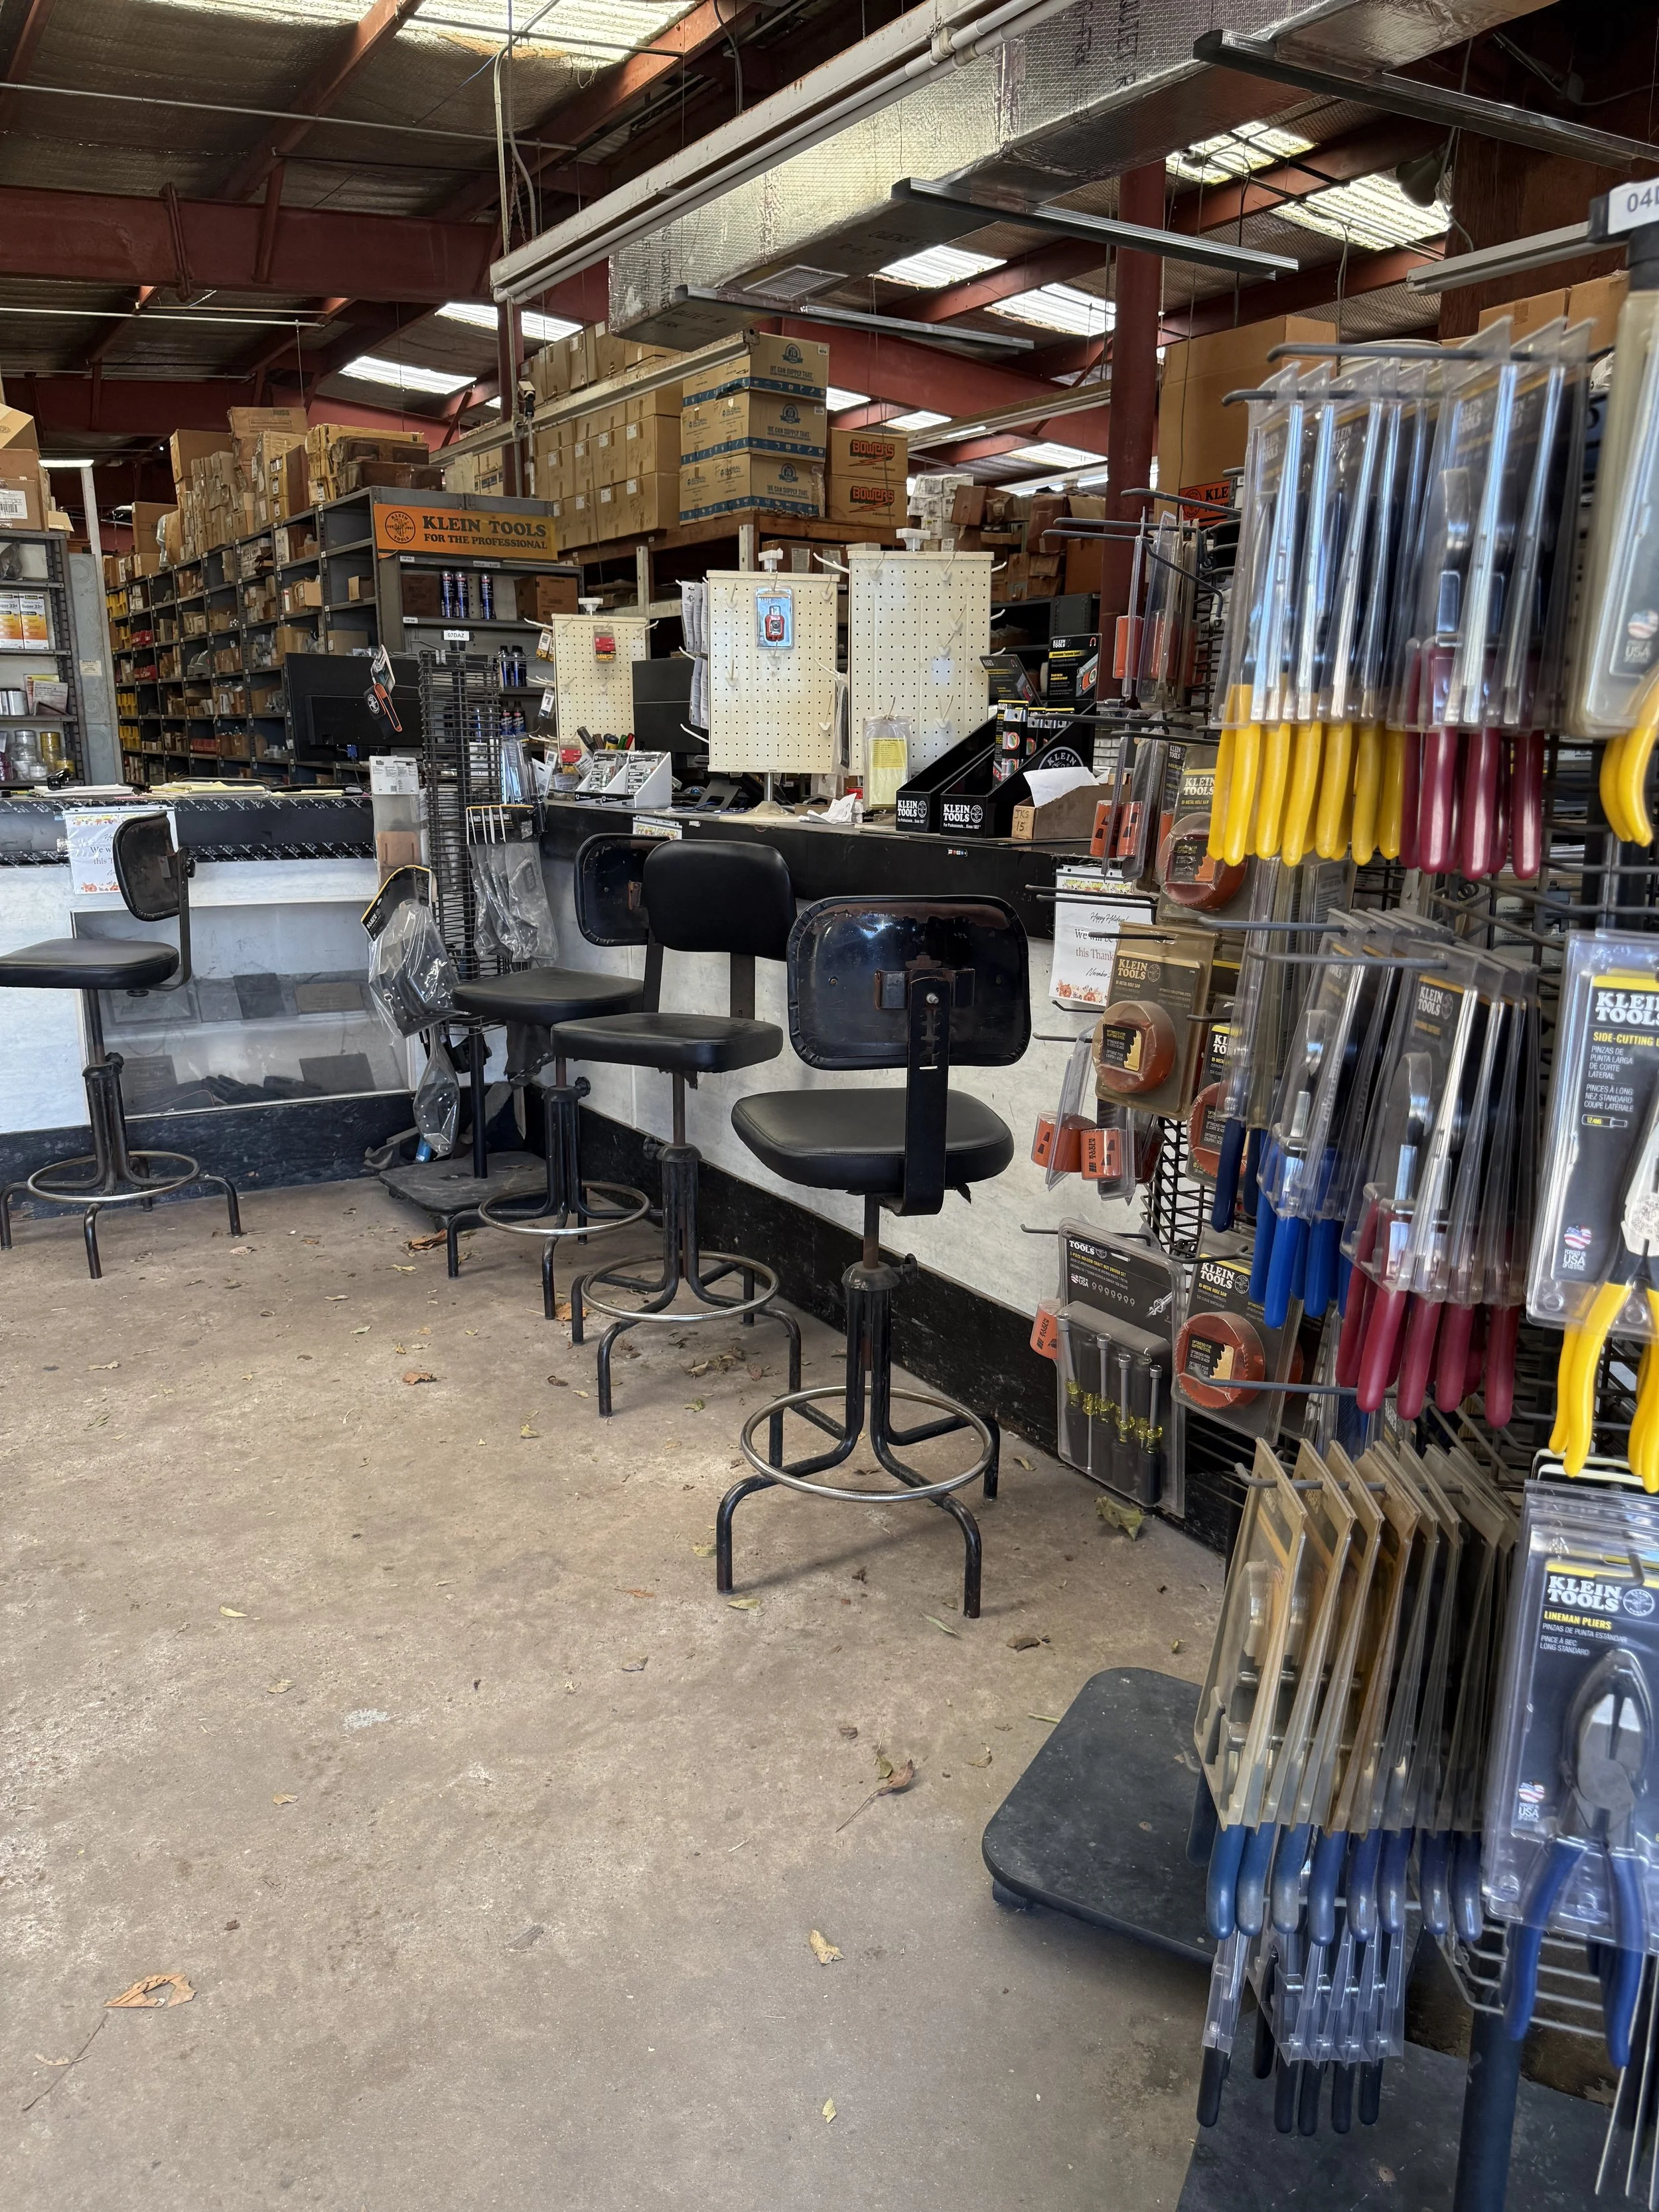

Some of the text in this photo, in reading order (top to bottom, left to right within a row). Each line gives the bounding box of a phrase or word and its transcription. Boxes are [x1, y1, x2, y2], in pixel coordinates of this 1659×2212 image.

[661, 249, 671, 310] CORNING
[851, 439, 895, 460] BOWERS
[851, 486, 895, 506] BOWERS
[1205, 486, 1228, 501] KLE
[422, 516, 546, 538] KLEIN TOOLS
[424, 533, 547, 550] FOR THE PROFESSIONAL
[1625, 646, 1650, 658] USA
[1047, 751, 1076, 766] KLEIN
[1185, 777, 1215, 787] KLEIN
[1184, 786, 1214, 796] TOOLS
[898, 800, 917, 809] KLEIN
[944, 804, 970, 814] KLEIN
[898, 808, 917, 818] TOOLS
[943, 812, 969, 822] TOOLS
[1014, 809, 1029, 819] JKS
[1017, 822, 1025, 832] 15
[1090, 913, 1105, 922] Happy
[1075, 929, 1087, 940] We
[1076, 948, 1089, 958] this
[1119, 959, 1147, 972] KLEIN
[1118, 968, 1146, 980] TOOLS
[1420, 986, 1443, 1004] KLEIN
[1418, 998, 1441, 1017] TOOLS
[1597, 992, 1659, 1011] KLEI
[1593, 1031, 1654, 1046] SIDE-CUTTING
[1591, 1046, 1613, 1055] PINZAS
[1590, 1054, 1633, 1065] PUNTA LARGA
[1599, 1063, 1620, 1072] CORTE
[1588, 1071, 1615, 1080] LATERAL
[1586, 1084, 1633, 1095] PINCES À LONG
[1599, 1094, 1632, 1104] STANDARD
[1584, 1100, 1634, 1112] COUPE LATÉRALE
[1069, 1240, 1095, 1255] TOOLS
[1563, 1254, 1585, 1266] USA
[1110, 1266, 1120, 1276] DRIVER
[1201, 1262, 1235, 1281] KLEIN
[1078, 1278, 1089, 1288] USA
[1200, 1270, 1233, 1290] TOOLS
[1198, 1283, 1212, 1291] BI-METAL
[1549, 1576, 1621, 1599] KLEIN
[1548, 1587, 1619, 1612] TOOLS
[1544, 1611, 1612, 1630] LINEMAN PLIERS
[1542, 1623, 1563, 1633] PINZAS
[1574, 1628, 1594, 1637] PUNTA
[1541, 1635, 1558, 1643] PINCE
[1557, 1645, 1590, 1656] STANDARD
[1518, 1806, 1540, 1818] USA
